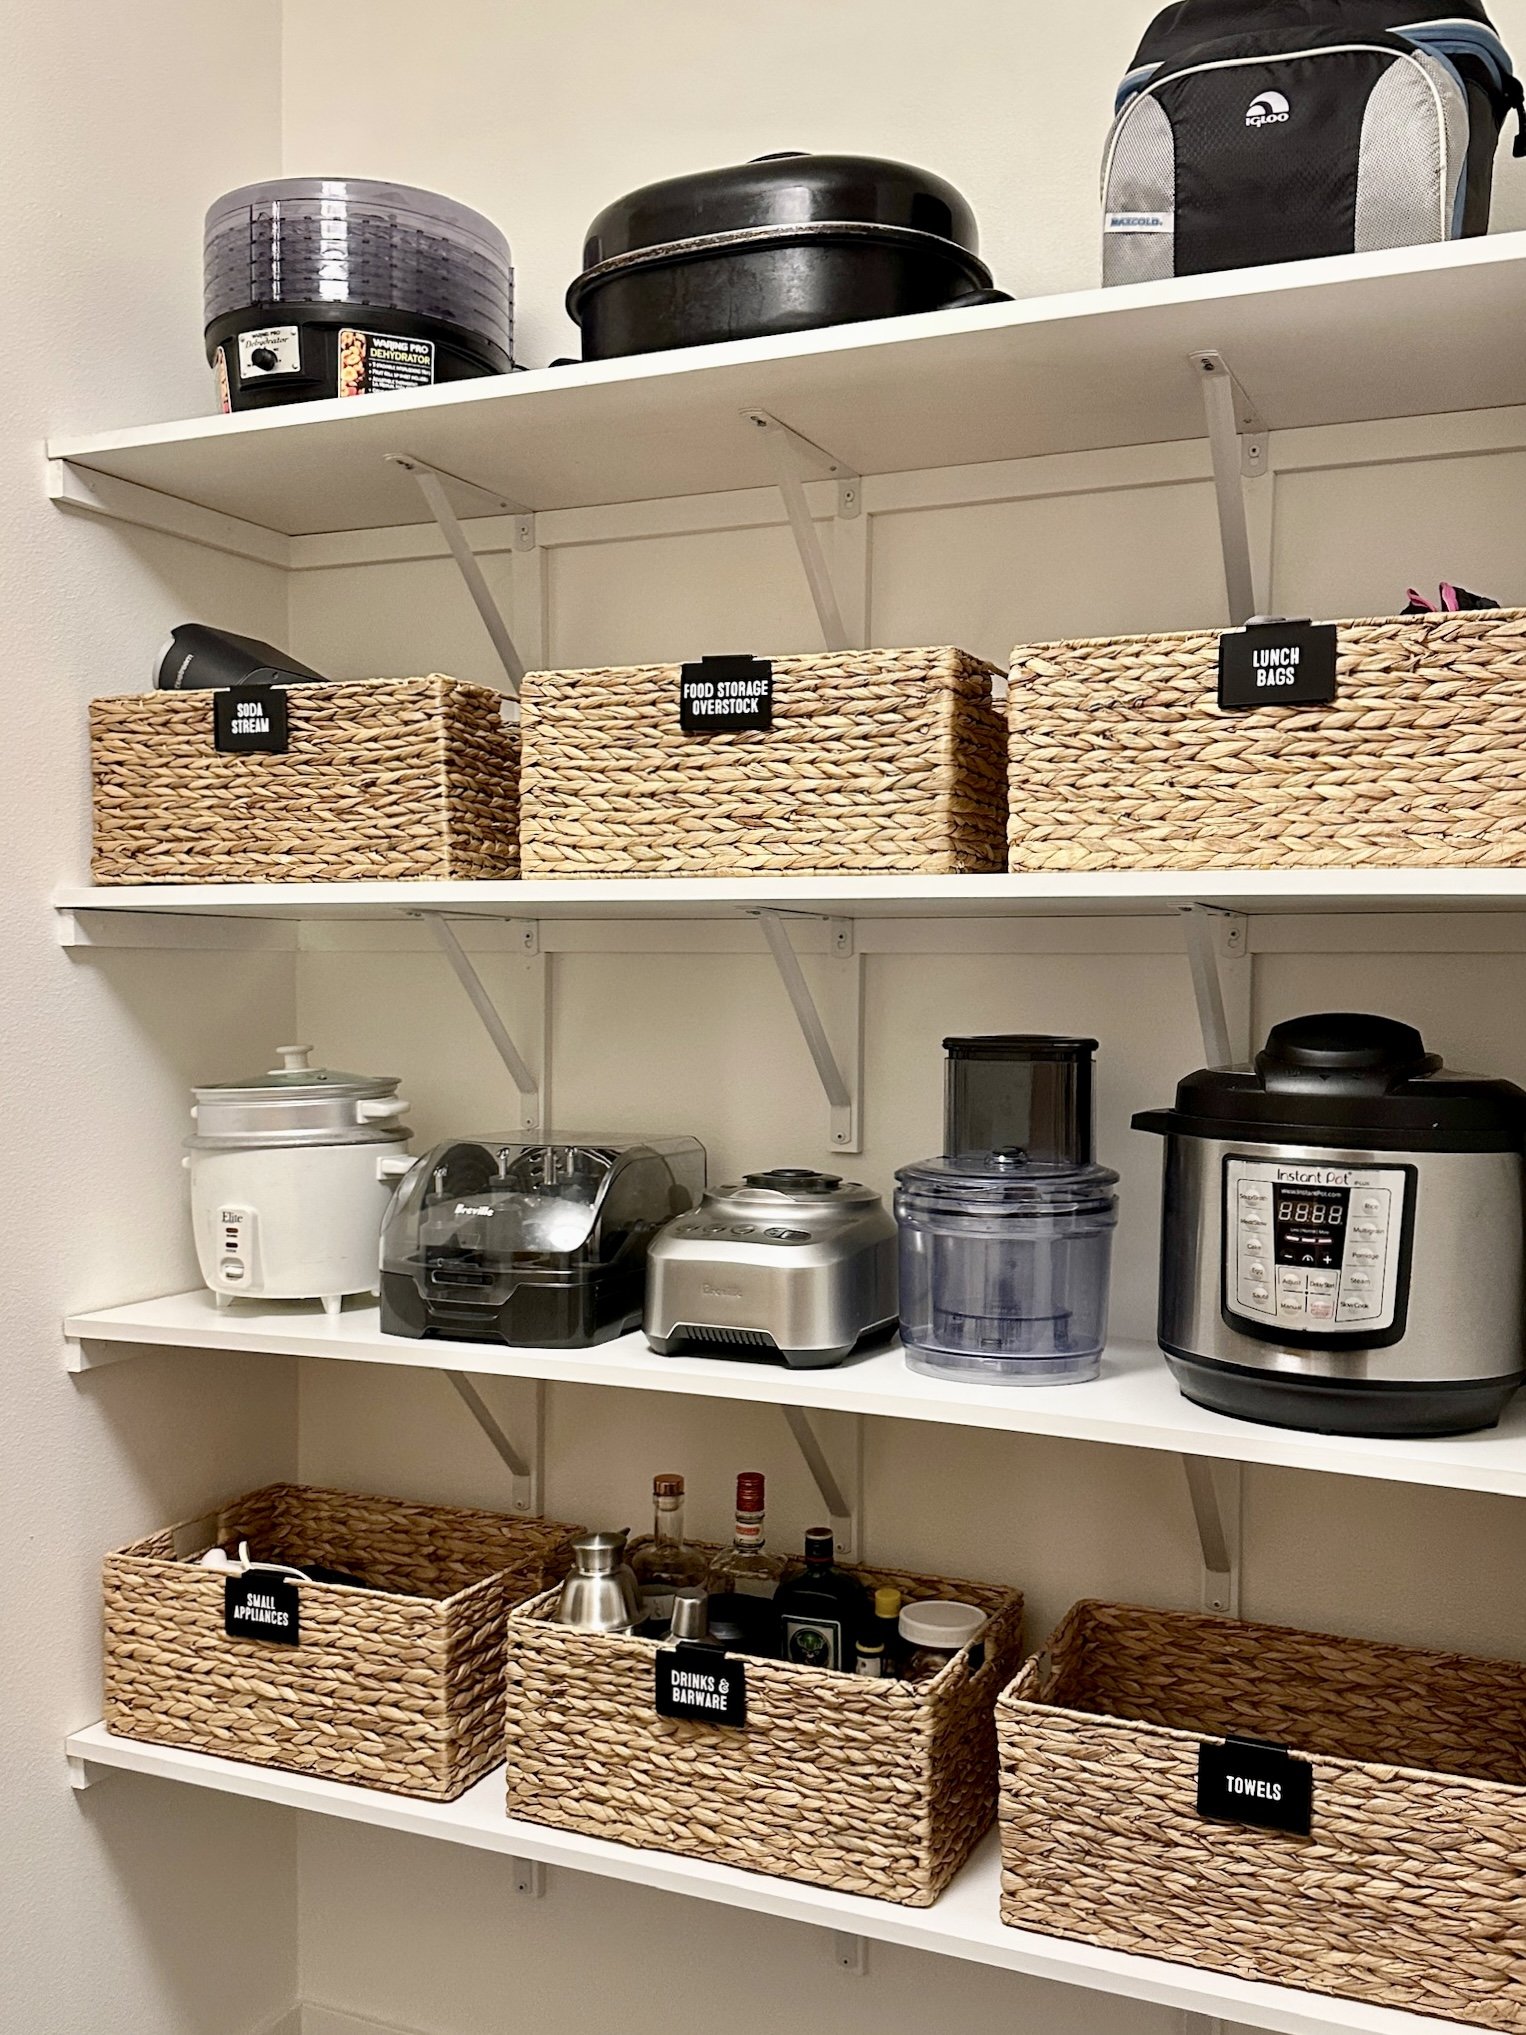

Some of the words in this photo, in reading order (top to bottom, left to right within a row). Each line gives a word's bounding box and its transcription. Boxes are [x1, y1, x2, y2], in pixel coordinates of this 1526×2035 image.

[1245, 113, 1290, 128] IGLOO
[372, 337, 409, 351] WARING
[409, 343, 429, 354] PRO
[370, 347, 431, 365] DEHYDRATOR
[1252, 647, 1300, 668] LUNCH
[1256, 667, 1295, 687] BAGS
[683, 682, 714, 699] FOOD
[717, 680, 769, 698] STORAGE
[236, 702, 263, 718] SODA
[692, 698, 759, 716] OVERSTOCK
[231, 718, 270, 734] STREAM
[1277, 1168, 1321, 1183] Instant
[1326, 1171, 1349, 1186] Pot
[222, 1211, 244, 1223] Elite
[454, 1203, 495, 1217] Breville
[246, 1593, 276, 1610] SMALL
[233, 1605, 289, 1627] APPLIANCES
[671, 1669, 715, 1692] DRINKS
[718, 1678, 730, 1694] &
[672, 1687, 728, 1711] BARWARE
[1226, 1775, 1281, 1801] TOWELS
